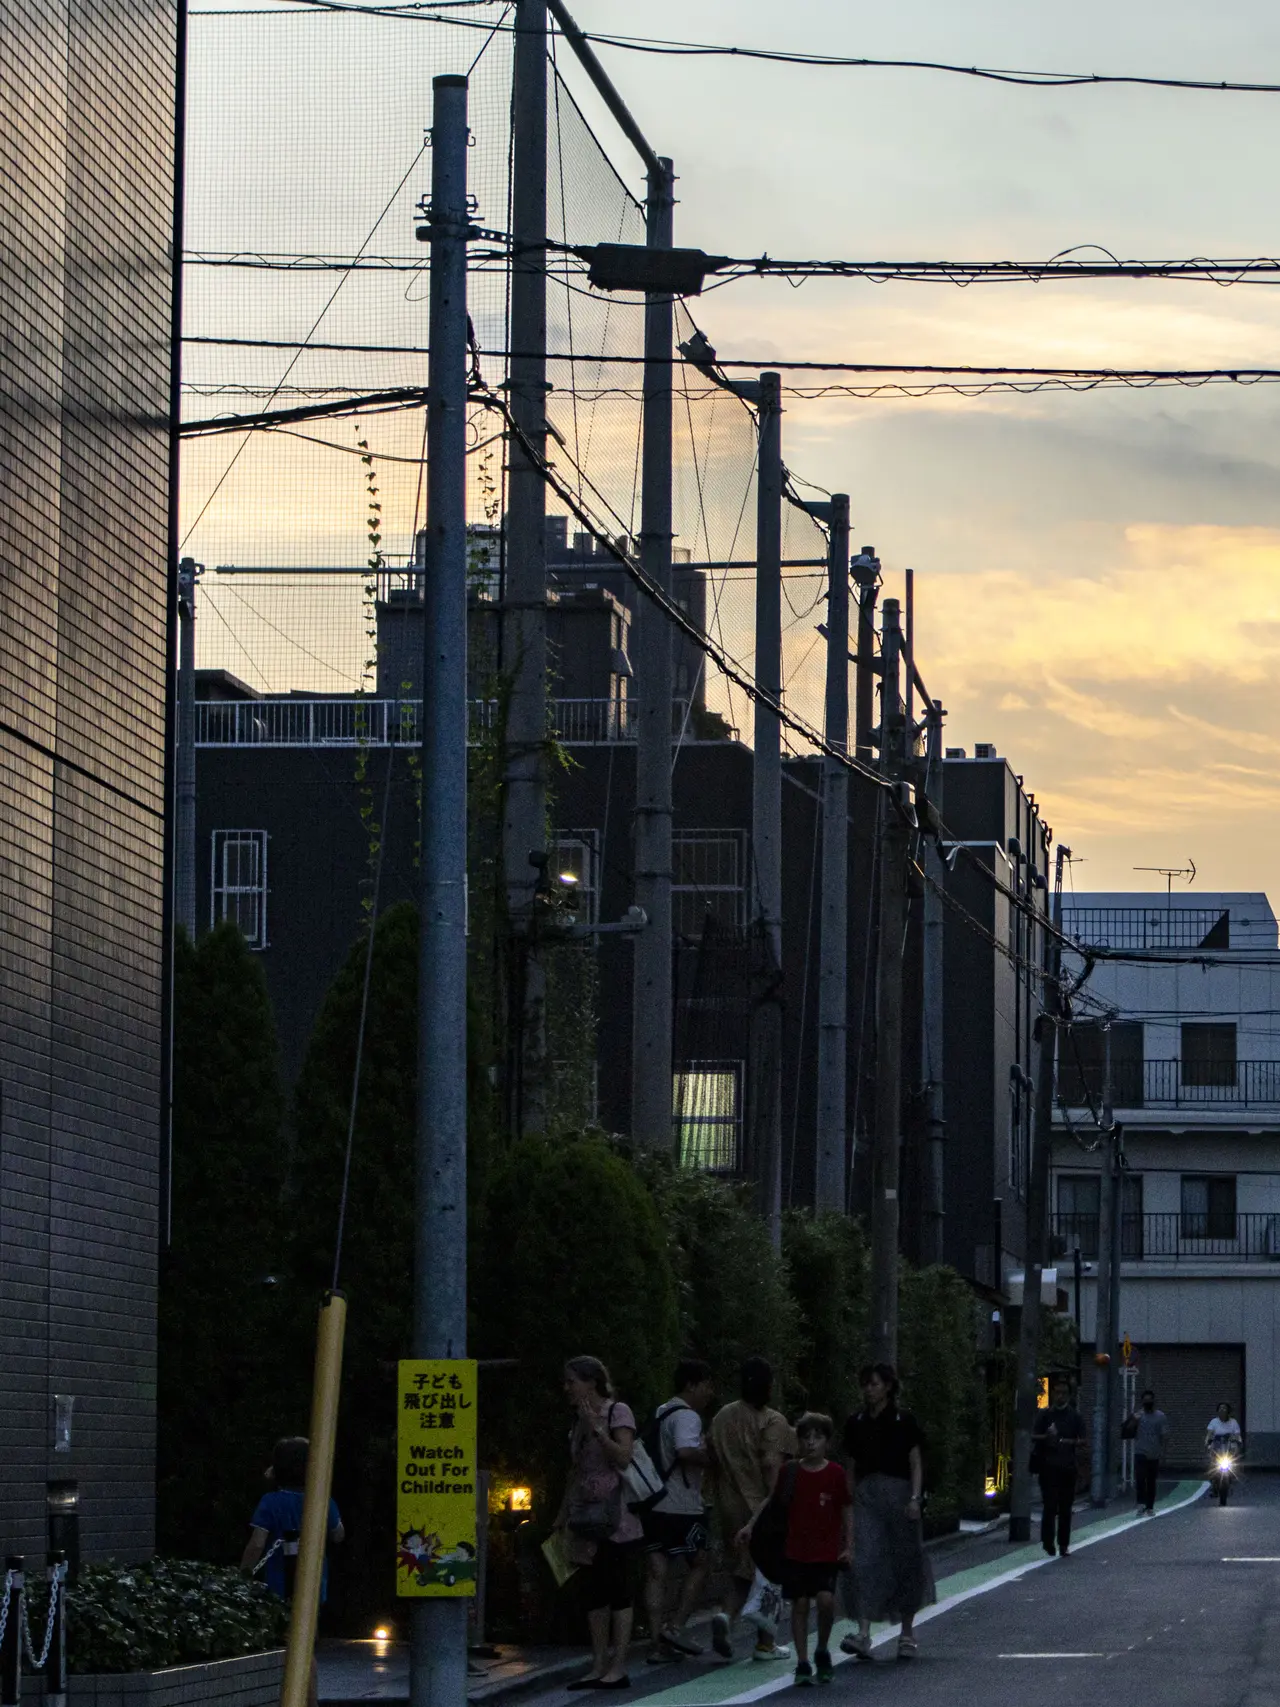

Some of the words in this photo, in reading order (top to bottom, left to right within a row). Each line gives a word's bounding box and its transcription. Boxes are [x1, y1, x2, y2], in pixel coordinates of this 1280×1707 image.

[413, 1373, 463, 1390] 子ども
[404, 1392, 473, 1410] 飛び出し
[420, 1411, 456, 1429] 注意
[410, 1445, 464, 1460] Watch
[405, 1462, 436, 1477] Out
[442, 1462, 470, 1477] For
[401, 1480, 474, 1494] Children
